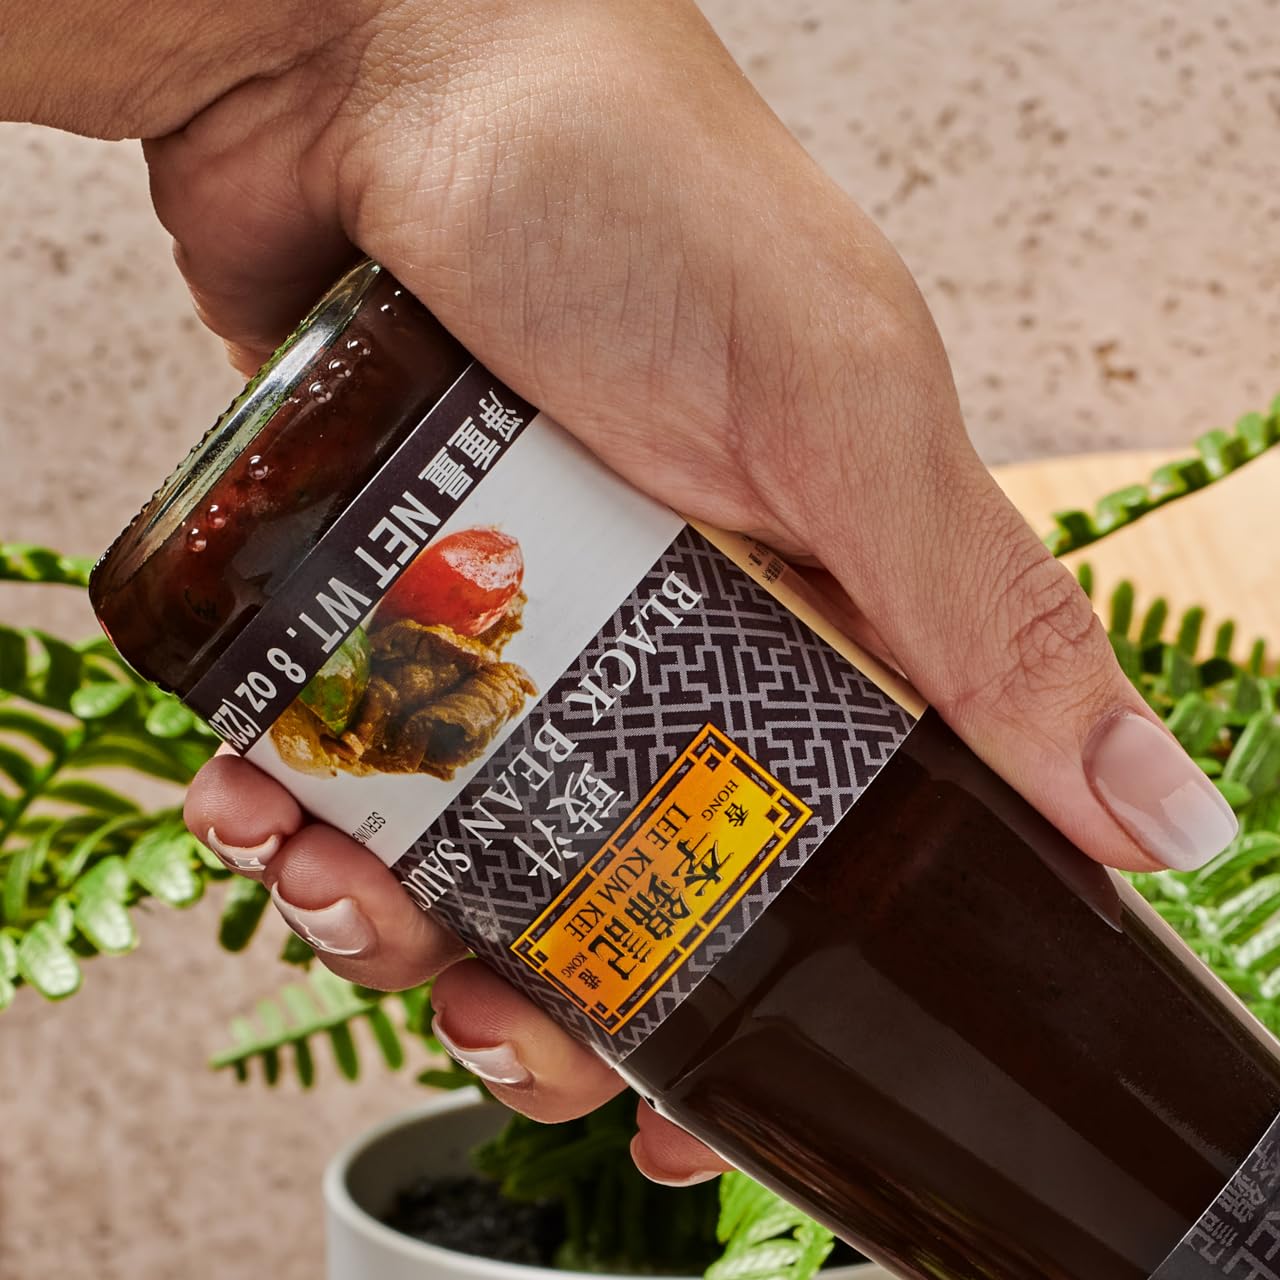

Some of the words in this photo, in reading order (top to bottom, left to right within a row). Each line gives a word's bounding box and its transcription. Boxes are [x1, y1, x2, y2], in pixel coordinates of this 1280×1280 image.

[416, 387, 526, 503] 淨重量
[345, 489, 441, 590] NET
[284, 574, 372, 656] WT.
[260, 642, 311, 687] 8
[561, 569, 702, 726] BLACK
[231, 666, 281, 714] oz
[456, 717, 579, 849] BEAN
[699, 778, 739, 822] HONG
[500, 756, 628, 891] 豉汁
[643, 801, 691, 852] LEE
[719, 797, 752, 831] 香
[584, 819, 740, 984] 李錦記
[594, 845, 653, 906] KUM
[561, 899, 605, 944] KEE
[559, 950, 587, 979] KONG
[575, 966, 603, 992] 港
